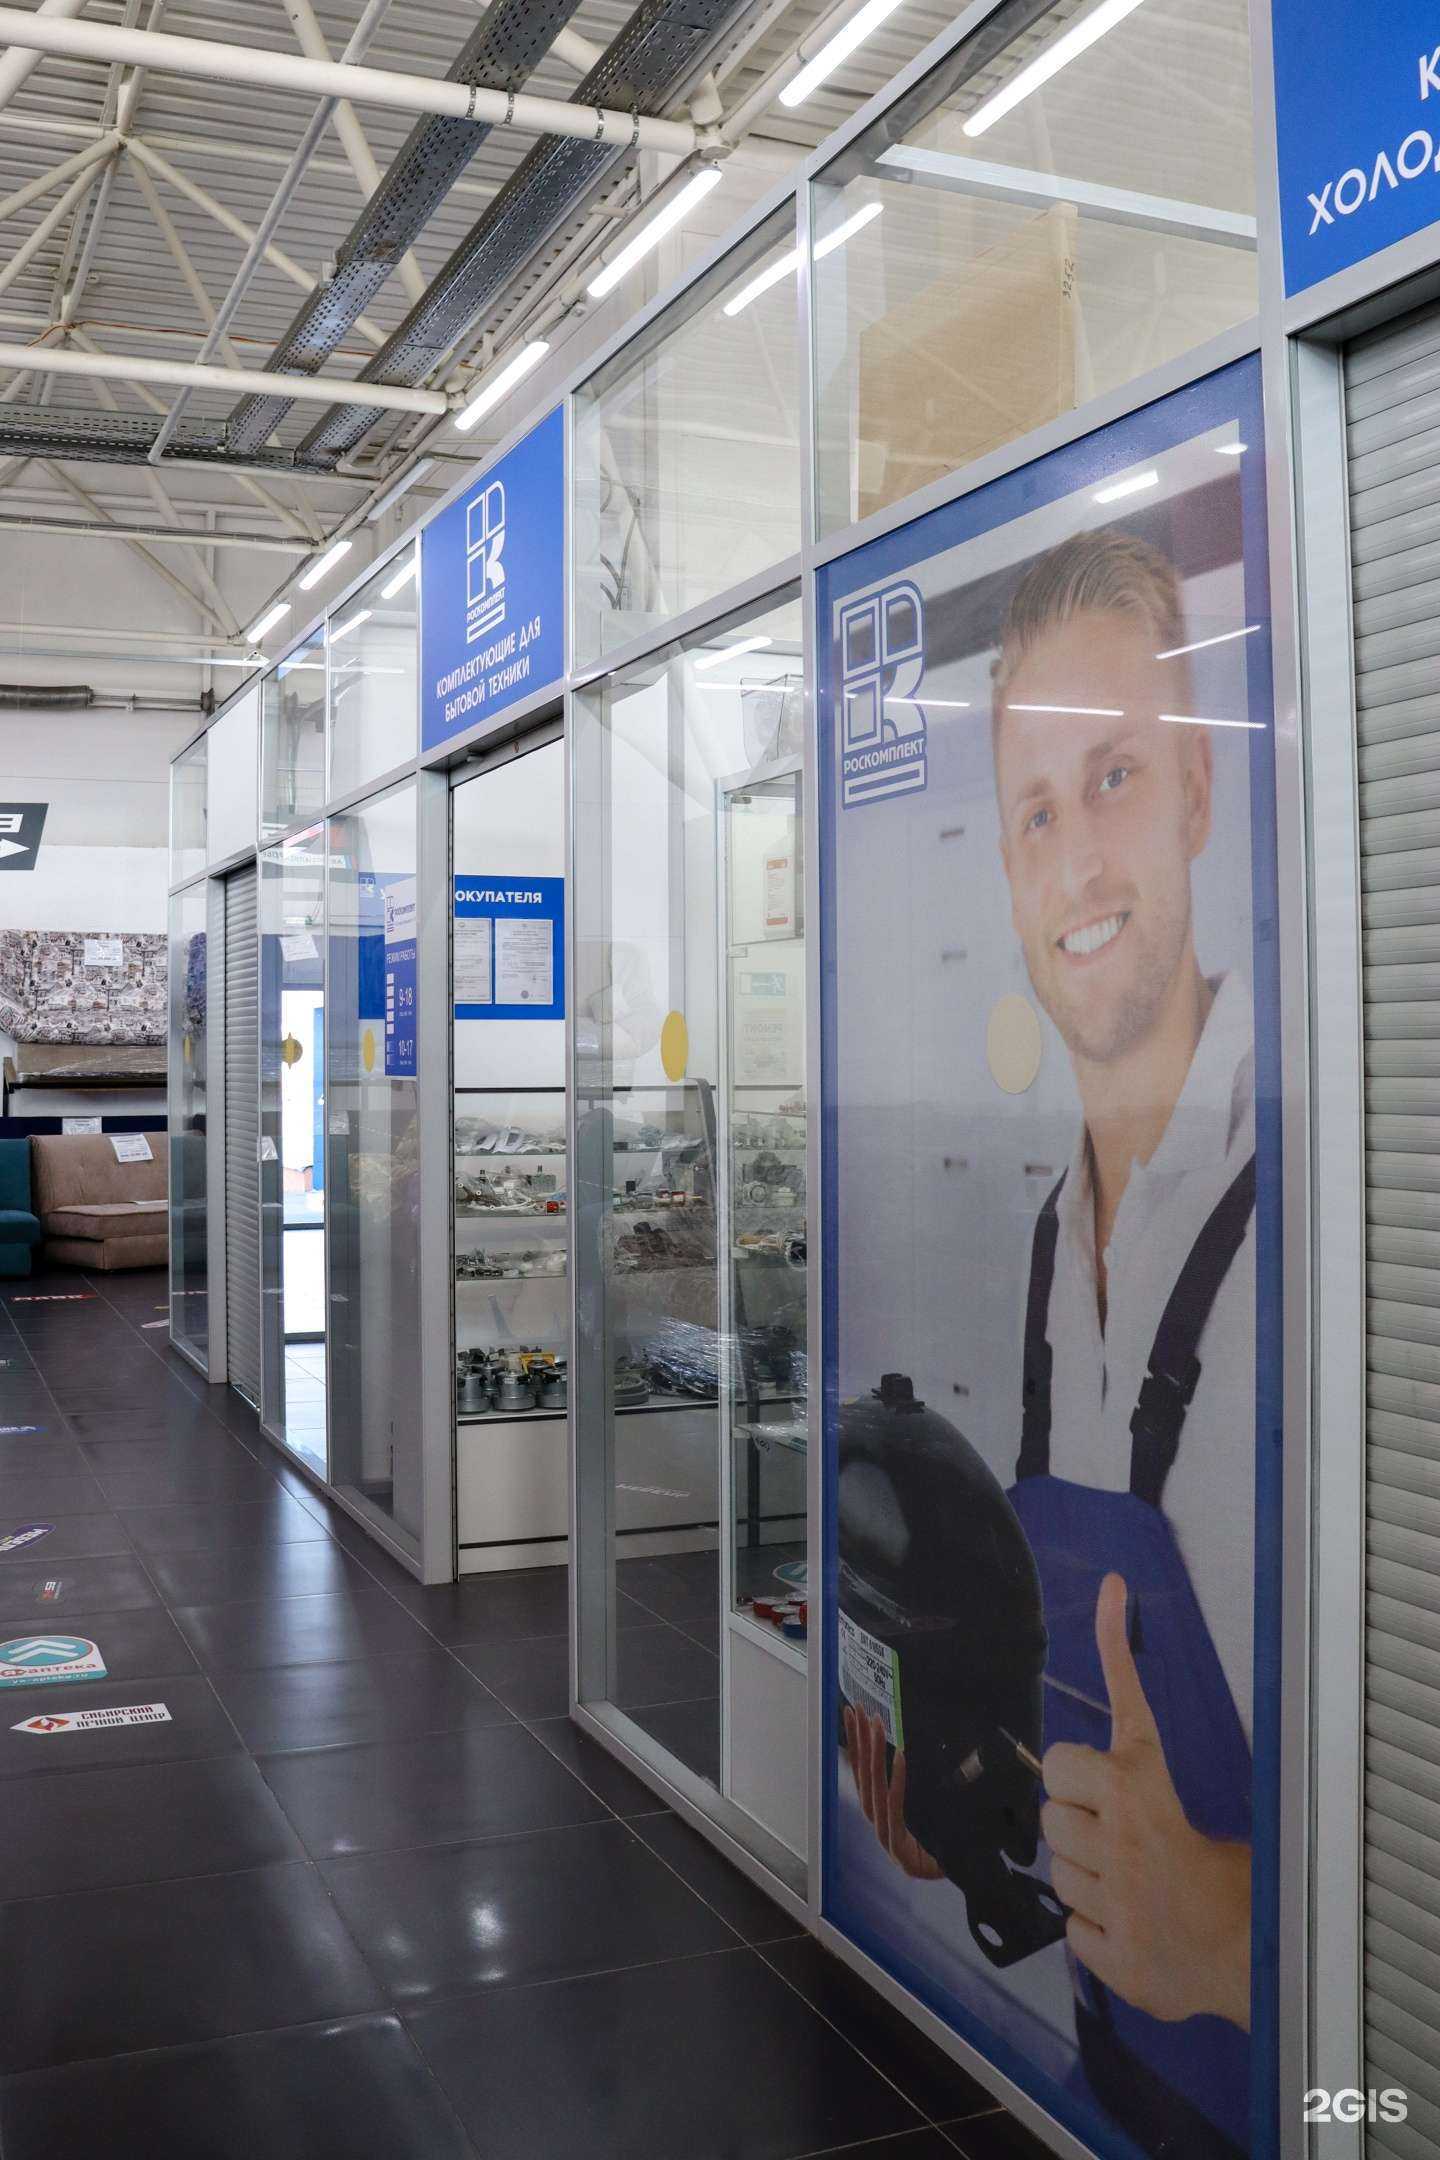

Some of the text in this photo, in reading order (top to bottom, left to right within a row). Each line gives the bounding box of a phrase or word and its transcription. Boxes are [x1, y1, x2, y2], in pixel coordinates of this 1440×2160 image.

[1306, 129, 1440, 236] ХОЛО
[466, 587, 505, 622] РОСКОМПЛЕКТ
[436, 615, 542, 699] КОМПЛЕКТУЮЩИЕ ДЛЯ
[444, 656, 530, 722] БЫТОВОЙ ТЕХНИКИ
[844, 738, 925, 774] РОСКОМПЛЕКТ
[399, 987, 413, 1006] 9-18
[398, 1040, 413, 1057] 10-17
[76, 1712, 166, 1728] ПЕЧНОЙ ЦЕНТР
[81, 1706, 154, 1719] СИБИРСКИЙ
